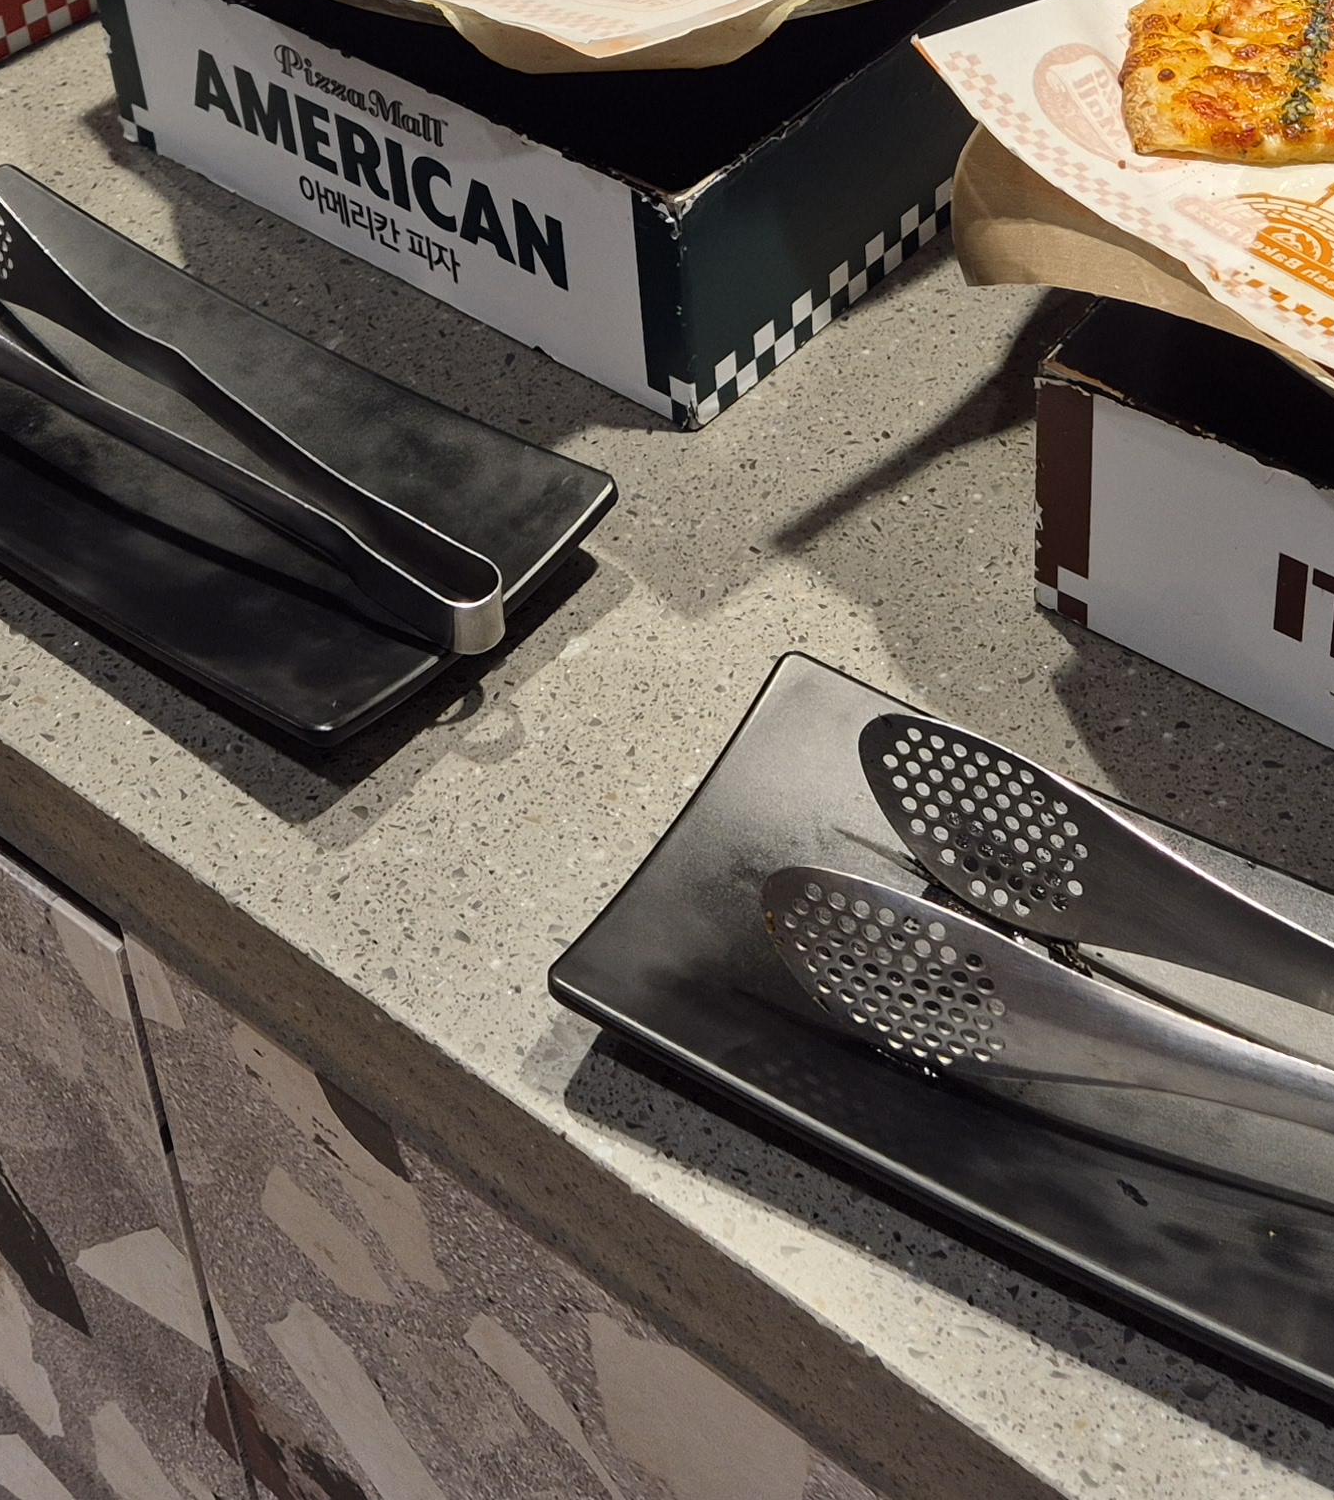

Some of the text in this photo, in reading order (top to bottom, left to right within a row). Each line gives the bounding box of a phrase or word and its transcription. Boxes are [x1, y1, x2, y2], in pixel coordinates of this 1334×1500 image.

[194, 49, 569, 291] AMERICAN
[299, 176, 461, 284] 아메리칸 피자
